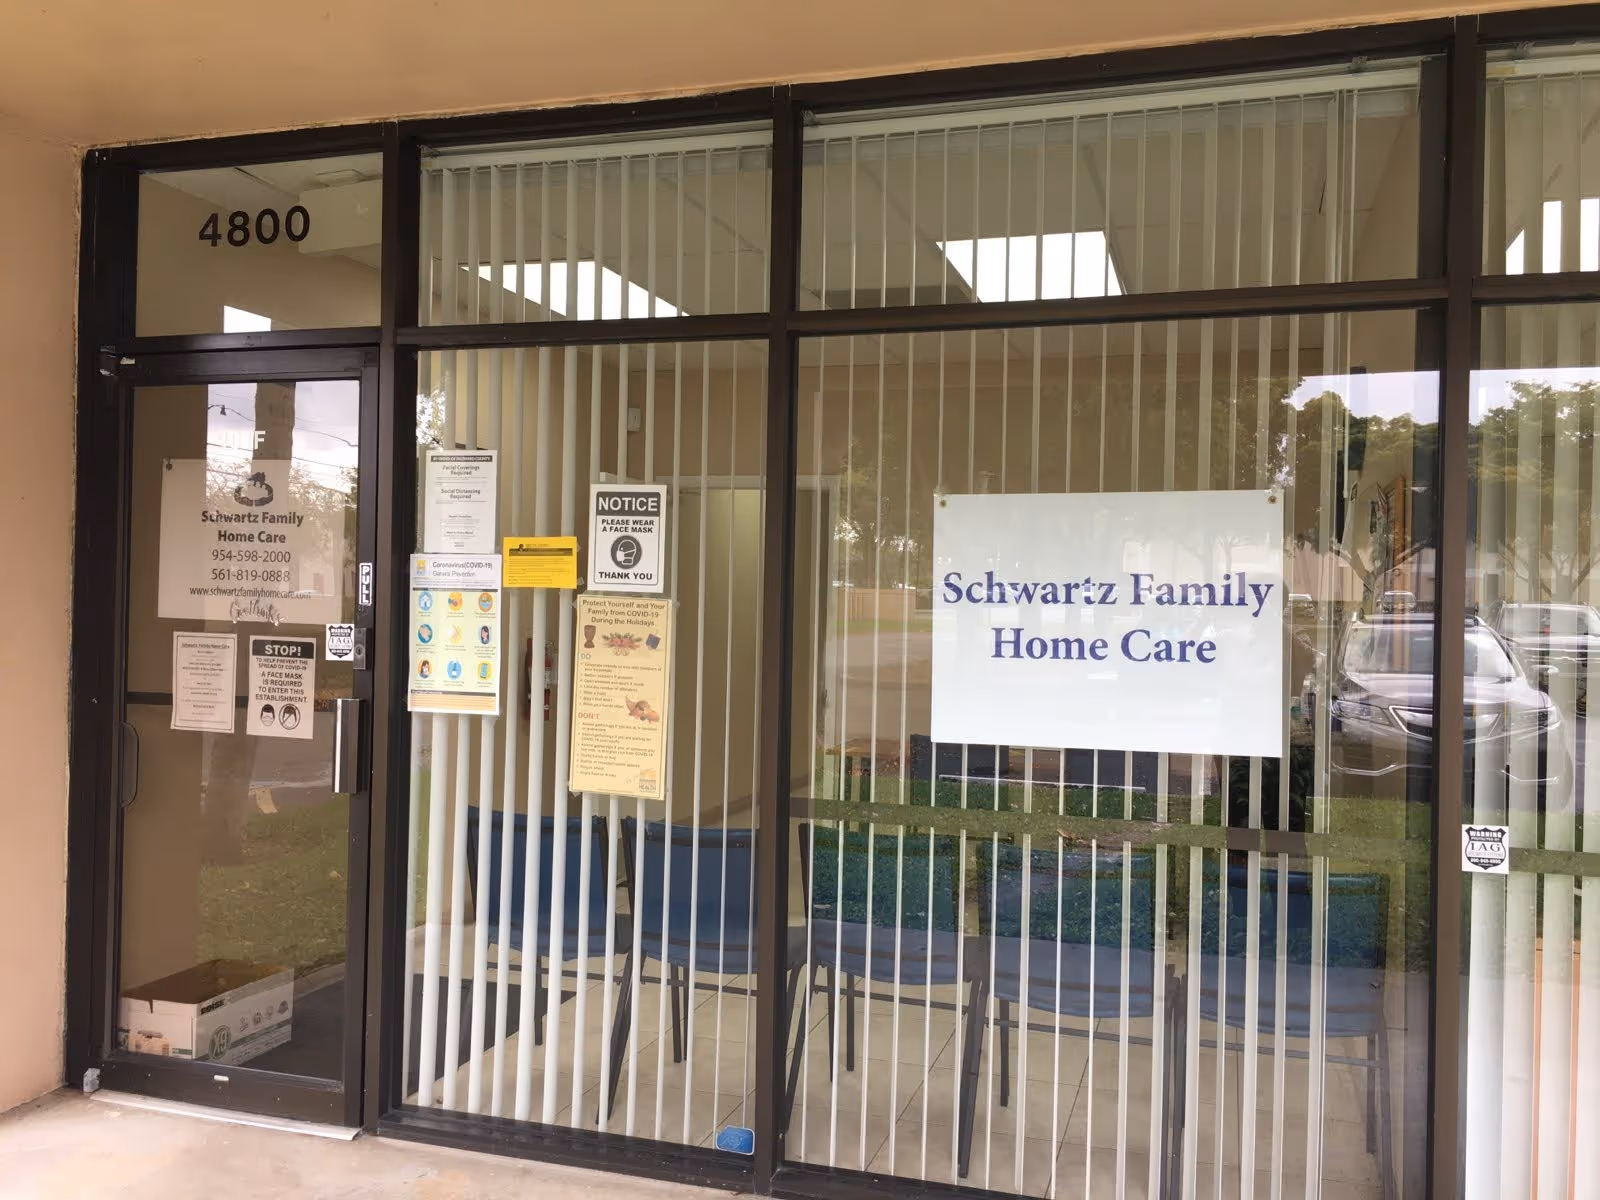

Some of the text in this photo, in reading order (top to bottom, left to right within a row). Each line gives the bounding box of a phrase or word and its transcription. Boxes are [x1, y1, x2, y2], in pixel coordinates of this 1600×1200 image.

[199, 205, 310, 247] 4800
[598, 496, 658, 512] NOTICE
[201, 510, 304, 527] Schwartz Family
[218, 530, 286, 543] Home Care
[212, 550, 291, 563] 954-598-2000
[211, 568, 290, 582] 561-819-0888
[599, 571, 653, 580] THANK YOU
[943, 571, 1274, 618] Schwartz Family
[587, 608, 609, 616] Family
[626, 610, 659, 618] COVID-19
[591, 617, 613, 625] During
[626, 619, 654, 627] Holidays
[265, 644, 301, 656] STOP!
[991, 627, 1217, 664] Home Care
